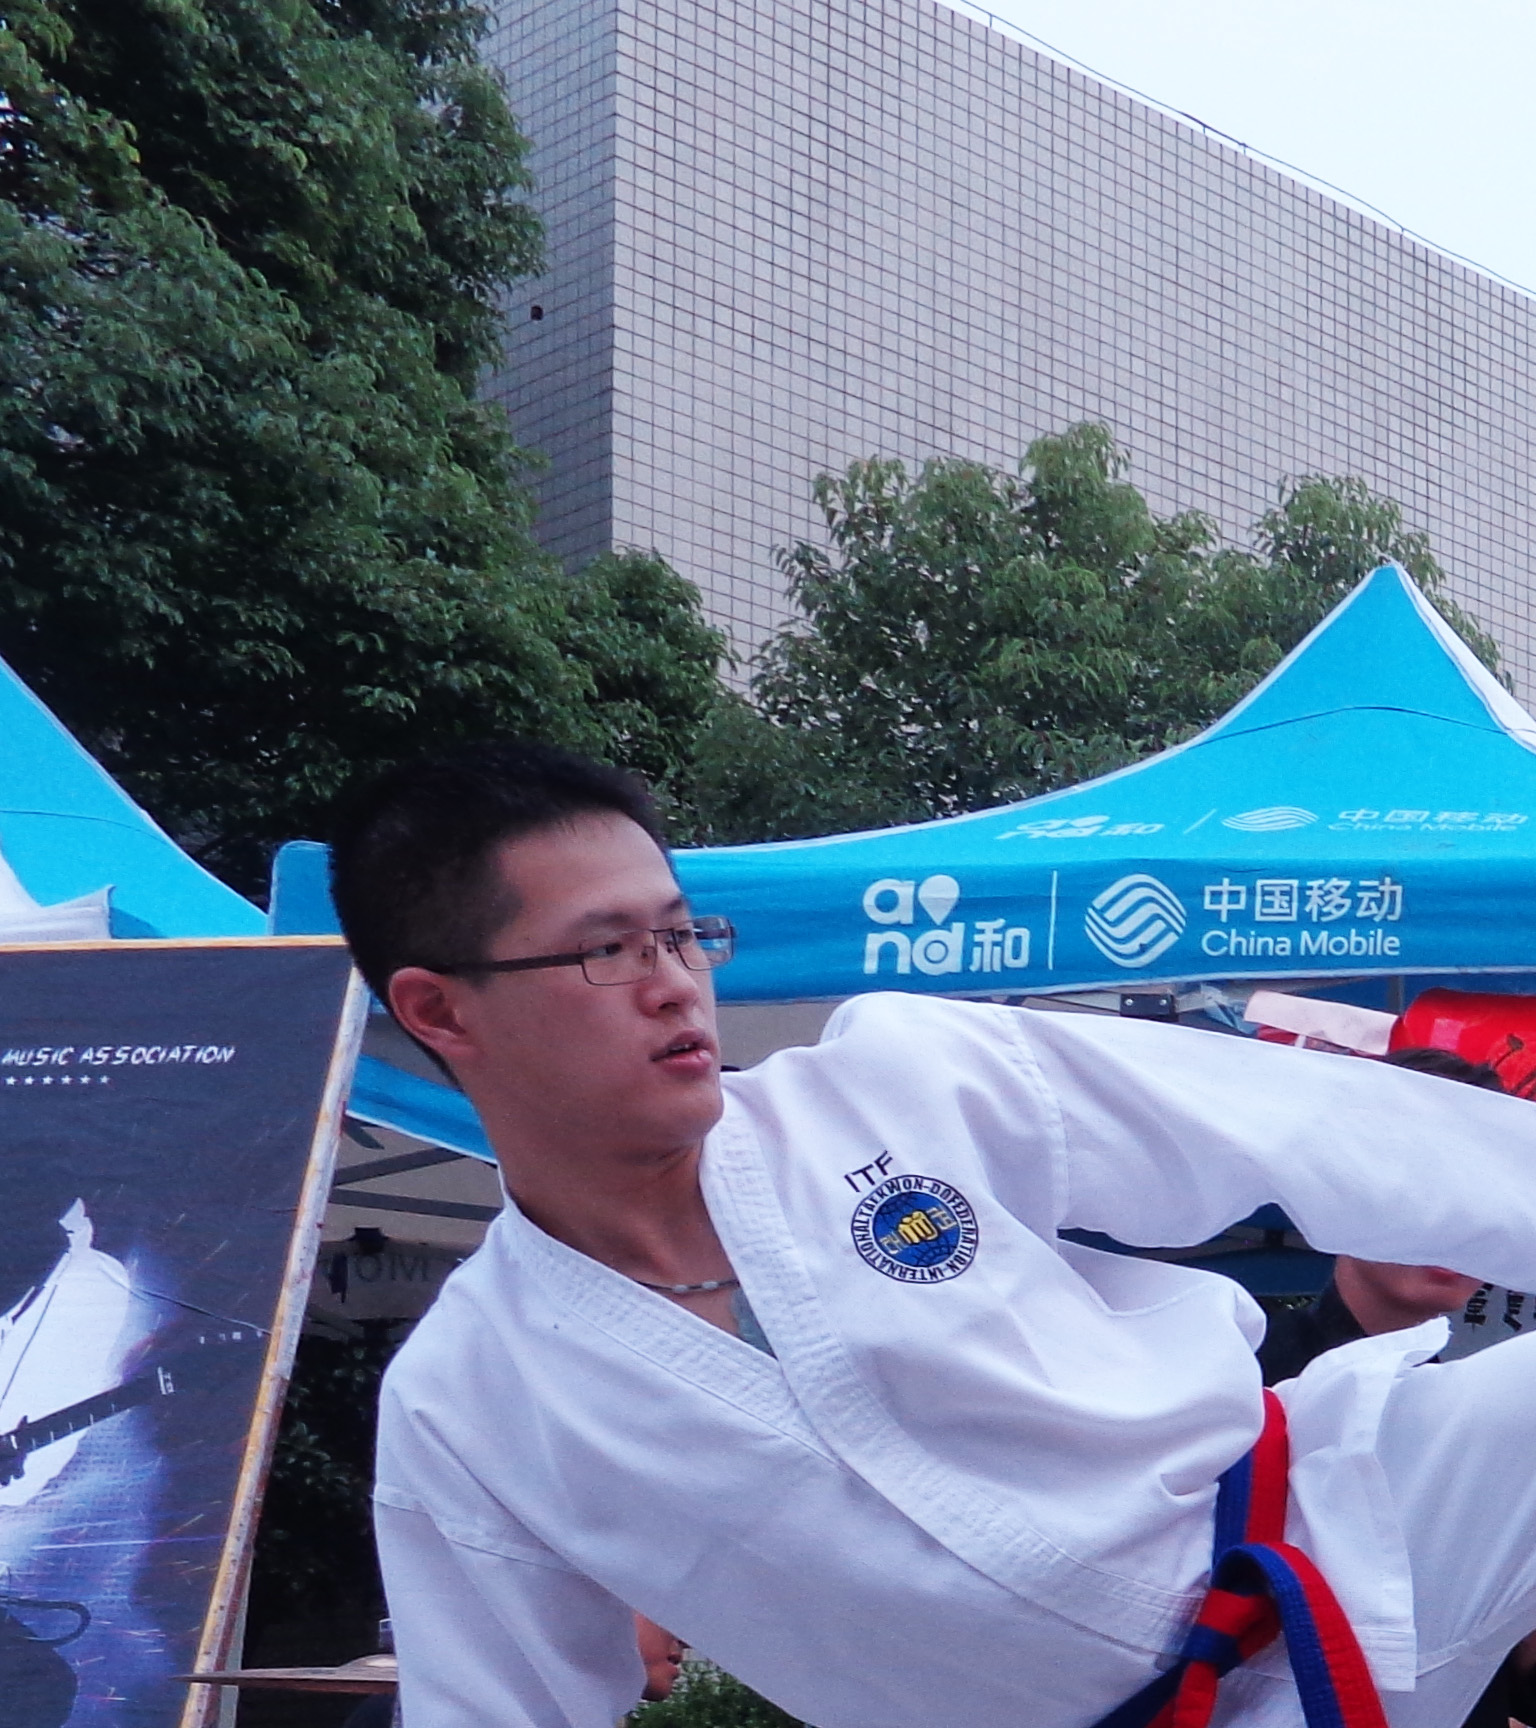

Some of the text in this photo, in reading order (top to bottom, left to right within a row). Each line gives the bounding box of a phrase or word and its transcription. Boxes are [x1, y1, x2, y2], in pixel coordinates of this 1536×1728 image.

[1338, 808, 1530, 824] 中国移动
[1203, 876, 1403, 924] 中国移动
[1202, 928, 1401, 957] China Mobile
[2, 1044, 237, 1067] MUSIC ASSOCIATION
[843, 1149, 894, 1193] ITF
